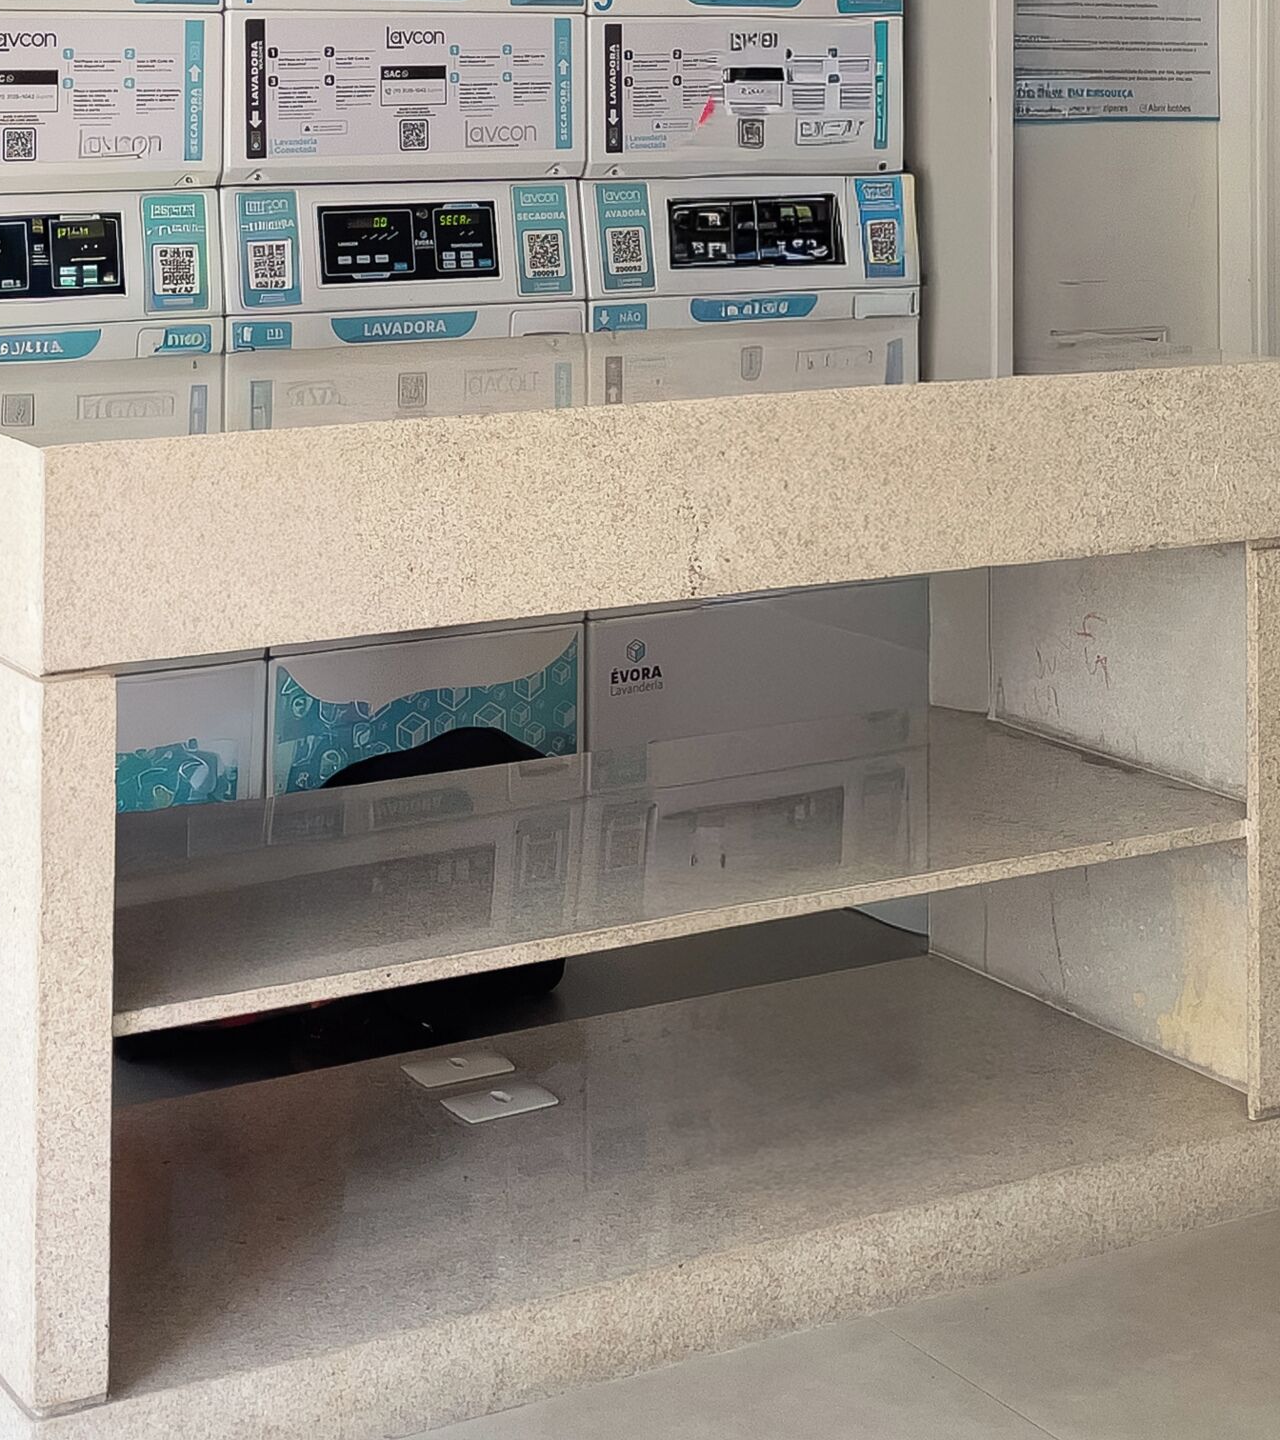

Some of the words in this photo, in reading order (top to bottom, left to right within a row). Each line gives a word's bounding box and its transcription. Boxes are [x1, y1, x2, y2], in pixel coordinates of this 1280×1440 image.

[251, 40, 259, 106] LAVADORA
[384, 70, 401, 78] SAC
[609, 44, 617, 105] LAVADORA
[560, 81, 568, 141] SECADORA
[517, 211, 566, 222] SECADORA
[619, 311, 641, 323] NÃO
[364, 319, 447, 337] LAVADORA
[610, 664, 663, 686] ÉVORA
[610, 678, 664, 697] Lavanderia
